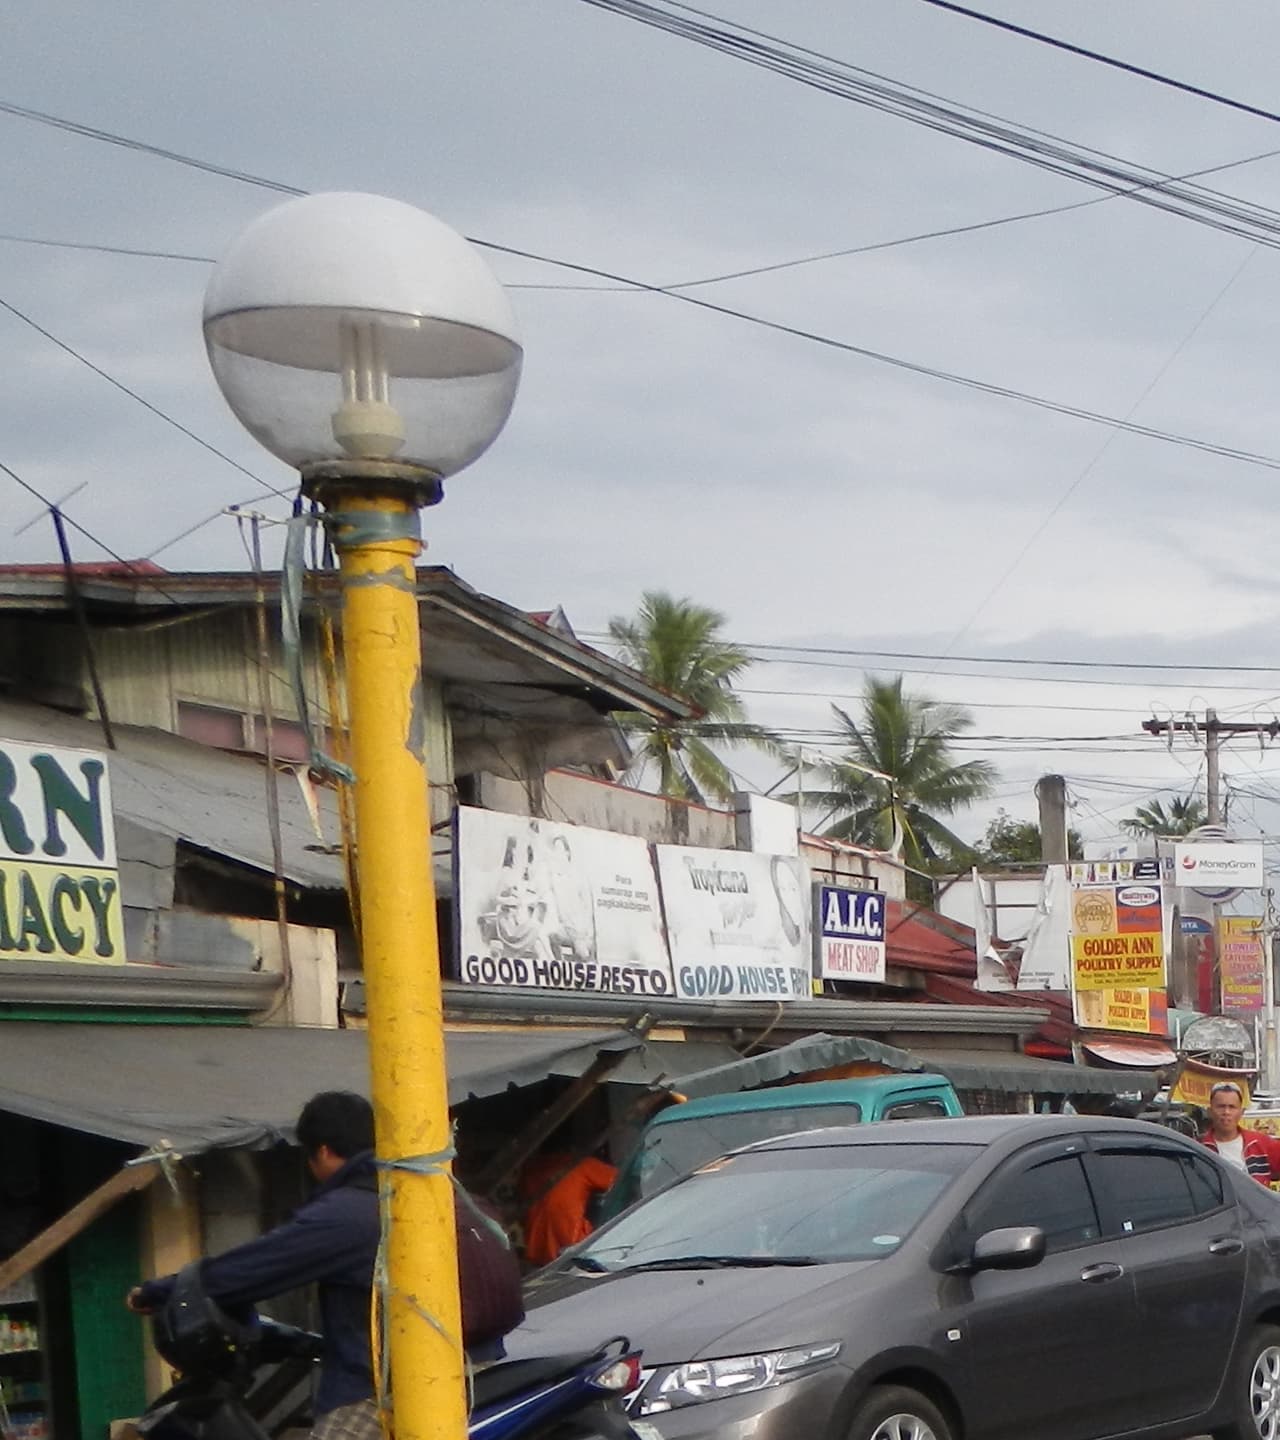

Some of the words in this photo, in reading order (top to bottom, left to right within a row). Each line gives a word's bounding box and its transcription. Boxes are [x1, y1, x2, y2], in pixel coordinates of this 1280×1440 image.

[682, 855, 749, 896] Tropicana
[1199, 860, 1256, 869] MoneyGram
[824, 891, 882, 937] A.L.C.
[828, 942, 854, 972] MEAT
[856, 946, 880, 973] SHOP
[1083, 938, 1128, 956] GOLDEN
[1132, 937, 1154, 954] ANN
[466, 955, 528, 984] GOOD
[533, 959, 597, 989] HOUSE
[600, 965, 667, 994] RESTO
[1077, 957, 1122, 971] POULTRY
[1125, 956, 1162, 969] SUPPLY
[679, 965, 734, 997] GOOD
[737, 966, 788, 995] HOUSE
